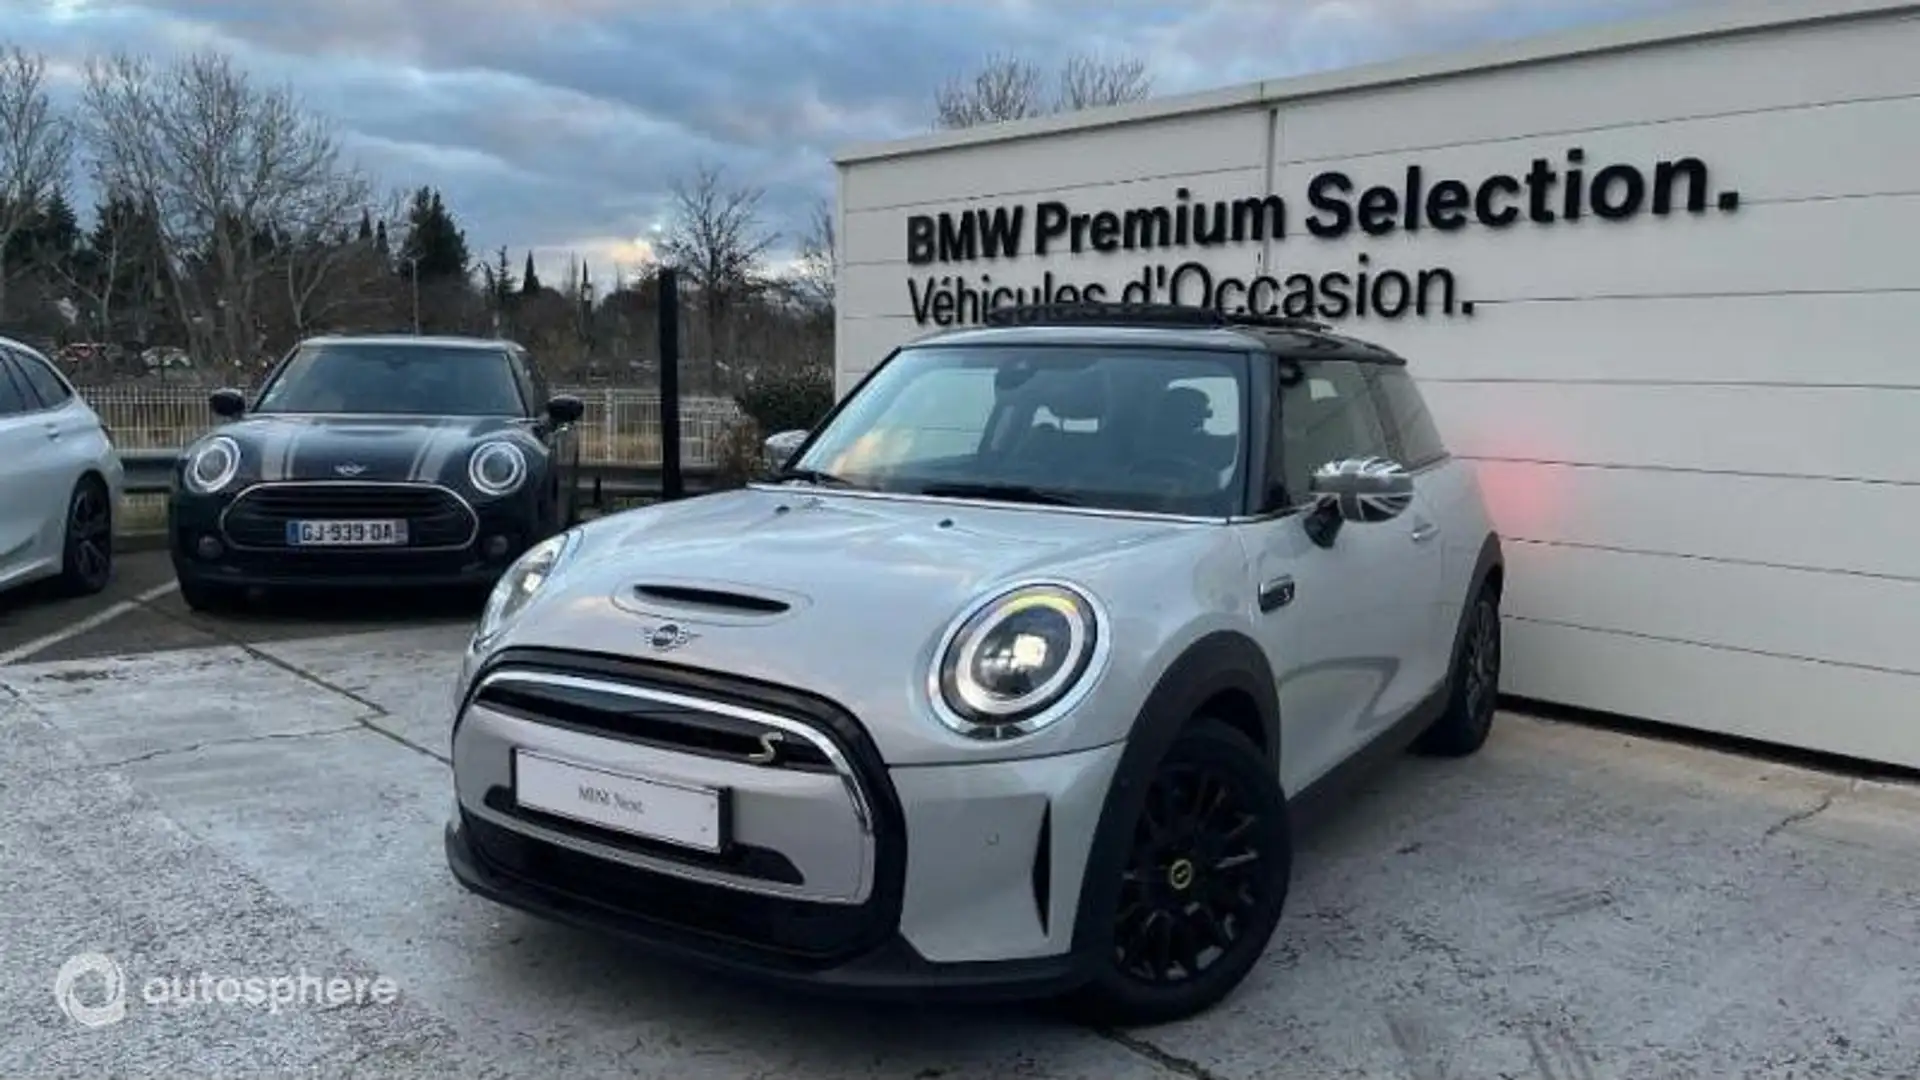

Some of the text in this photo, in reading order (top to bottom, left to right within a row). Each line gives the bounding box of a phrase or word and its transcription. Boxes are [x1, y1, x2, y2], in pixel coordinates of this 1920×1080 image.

[907, 148, 1739, 264] BMW Premium Selection.
